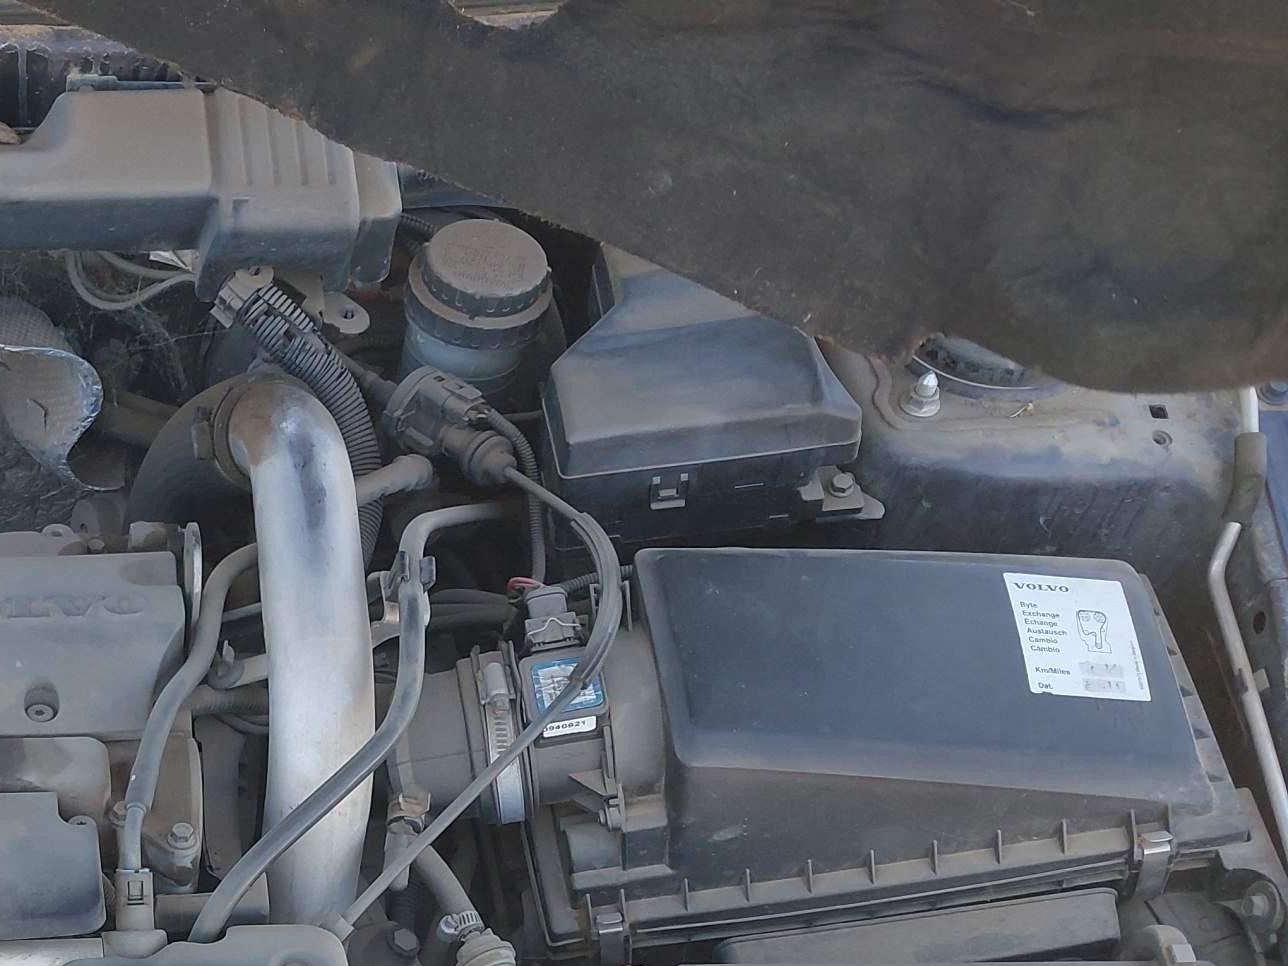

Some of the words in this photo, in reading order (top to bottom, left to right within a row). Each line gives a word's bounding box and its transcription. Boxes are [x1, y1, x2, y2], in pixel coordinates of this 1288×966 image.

[1013, 582, 1070, 593] VOLVO
[1019, 601, 1038, 609] Byte
[1022, 610, 1060, 619] Exchange
[1026, 627, 1068, 636] Austausch
[1028, 636, 1058, 644] Cambio
[1035, 667, 1072, 676] Km/Miles
